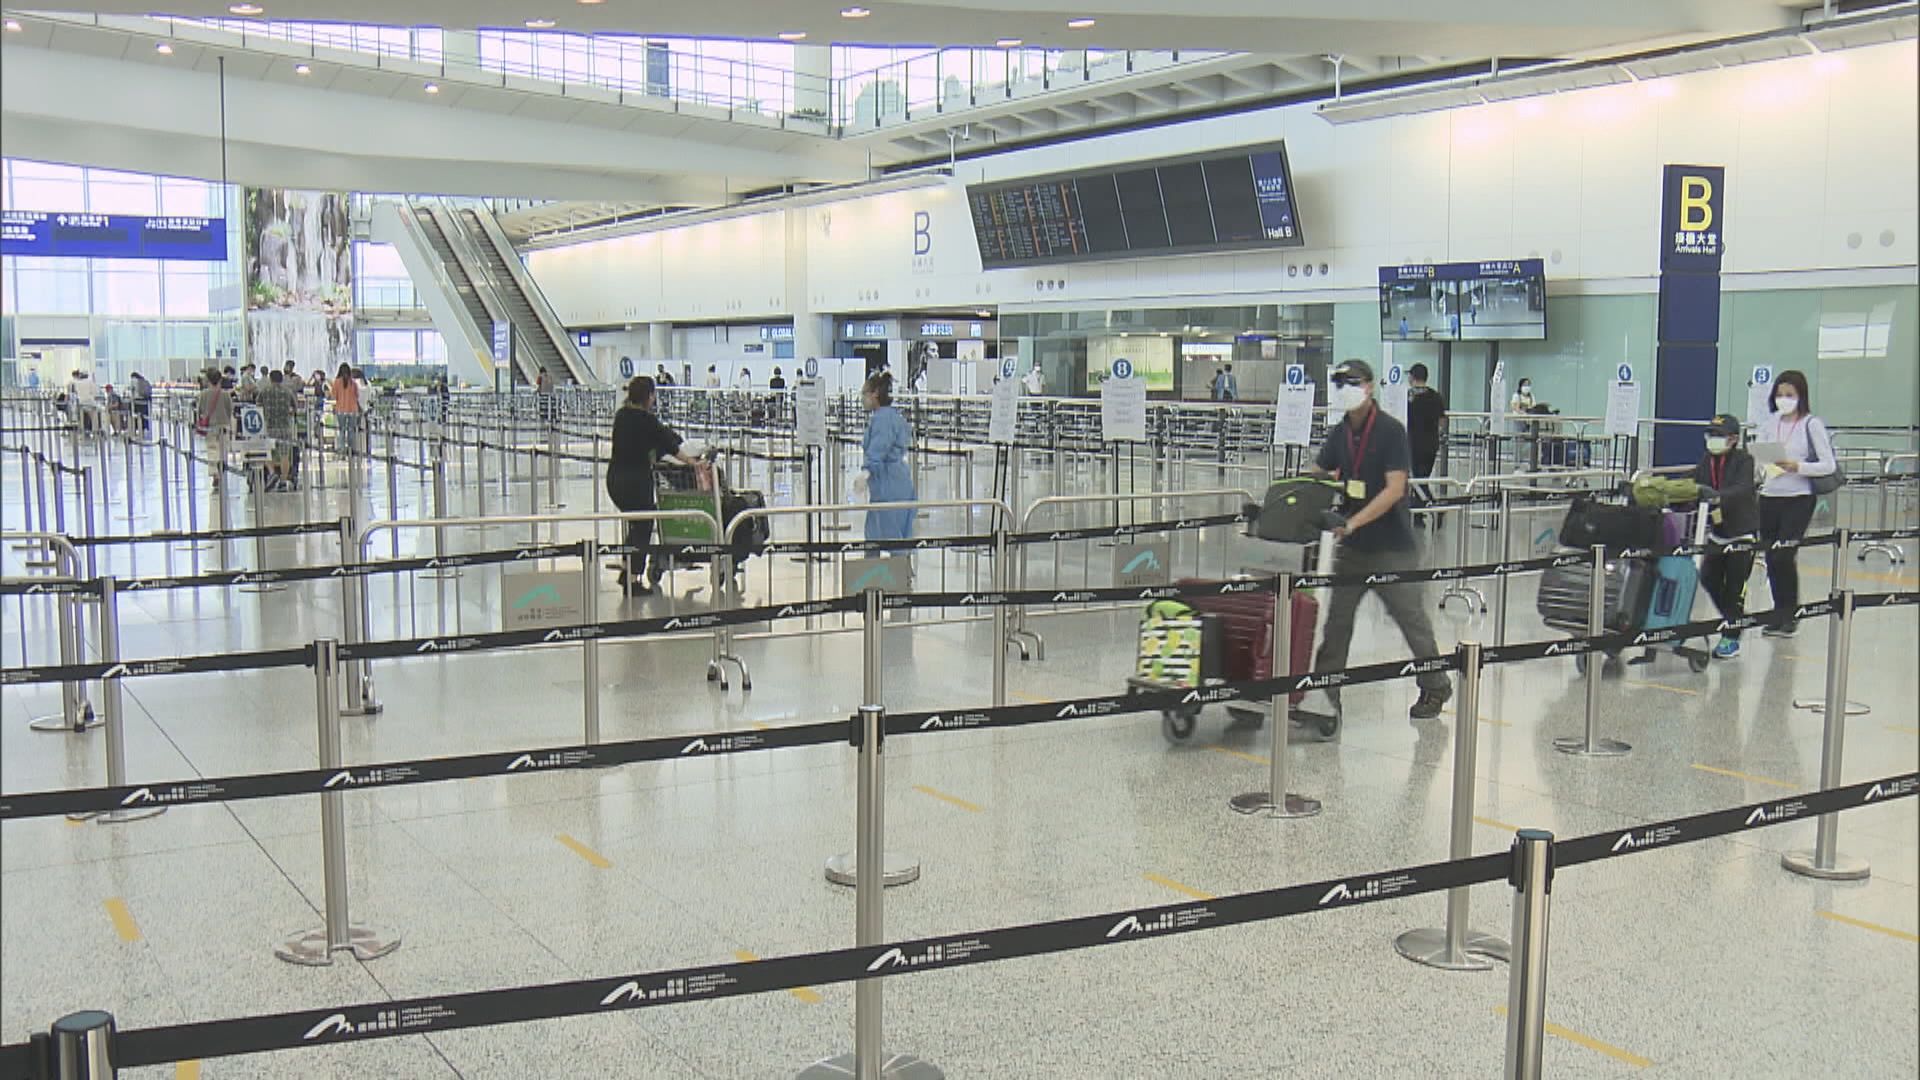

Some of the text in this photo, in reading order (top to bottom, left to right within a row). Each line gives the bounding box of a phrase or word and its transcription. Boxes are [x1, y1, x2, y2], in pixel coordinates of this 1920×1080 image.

[1680, 175, 1713, 232] B
[914, 211, 931, 255] B
[1267, 226, 1292, 239] Hall B
[1675, 244, 1716, 254] Arrivals Hall
[1428, 266, 1435, 278] B
[1513, 262, 1521, 274] A
[1117, 361, 1128, 377] 8
[1390, 367, 1398, 382] 6
[1290, 369, 1300, 383] 7
[246, 413, 261, 430] 14
[402, 1009, 456, 1021] INTERNATIONAL
[402, 1018, 432, 1028] AIRPORT
